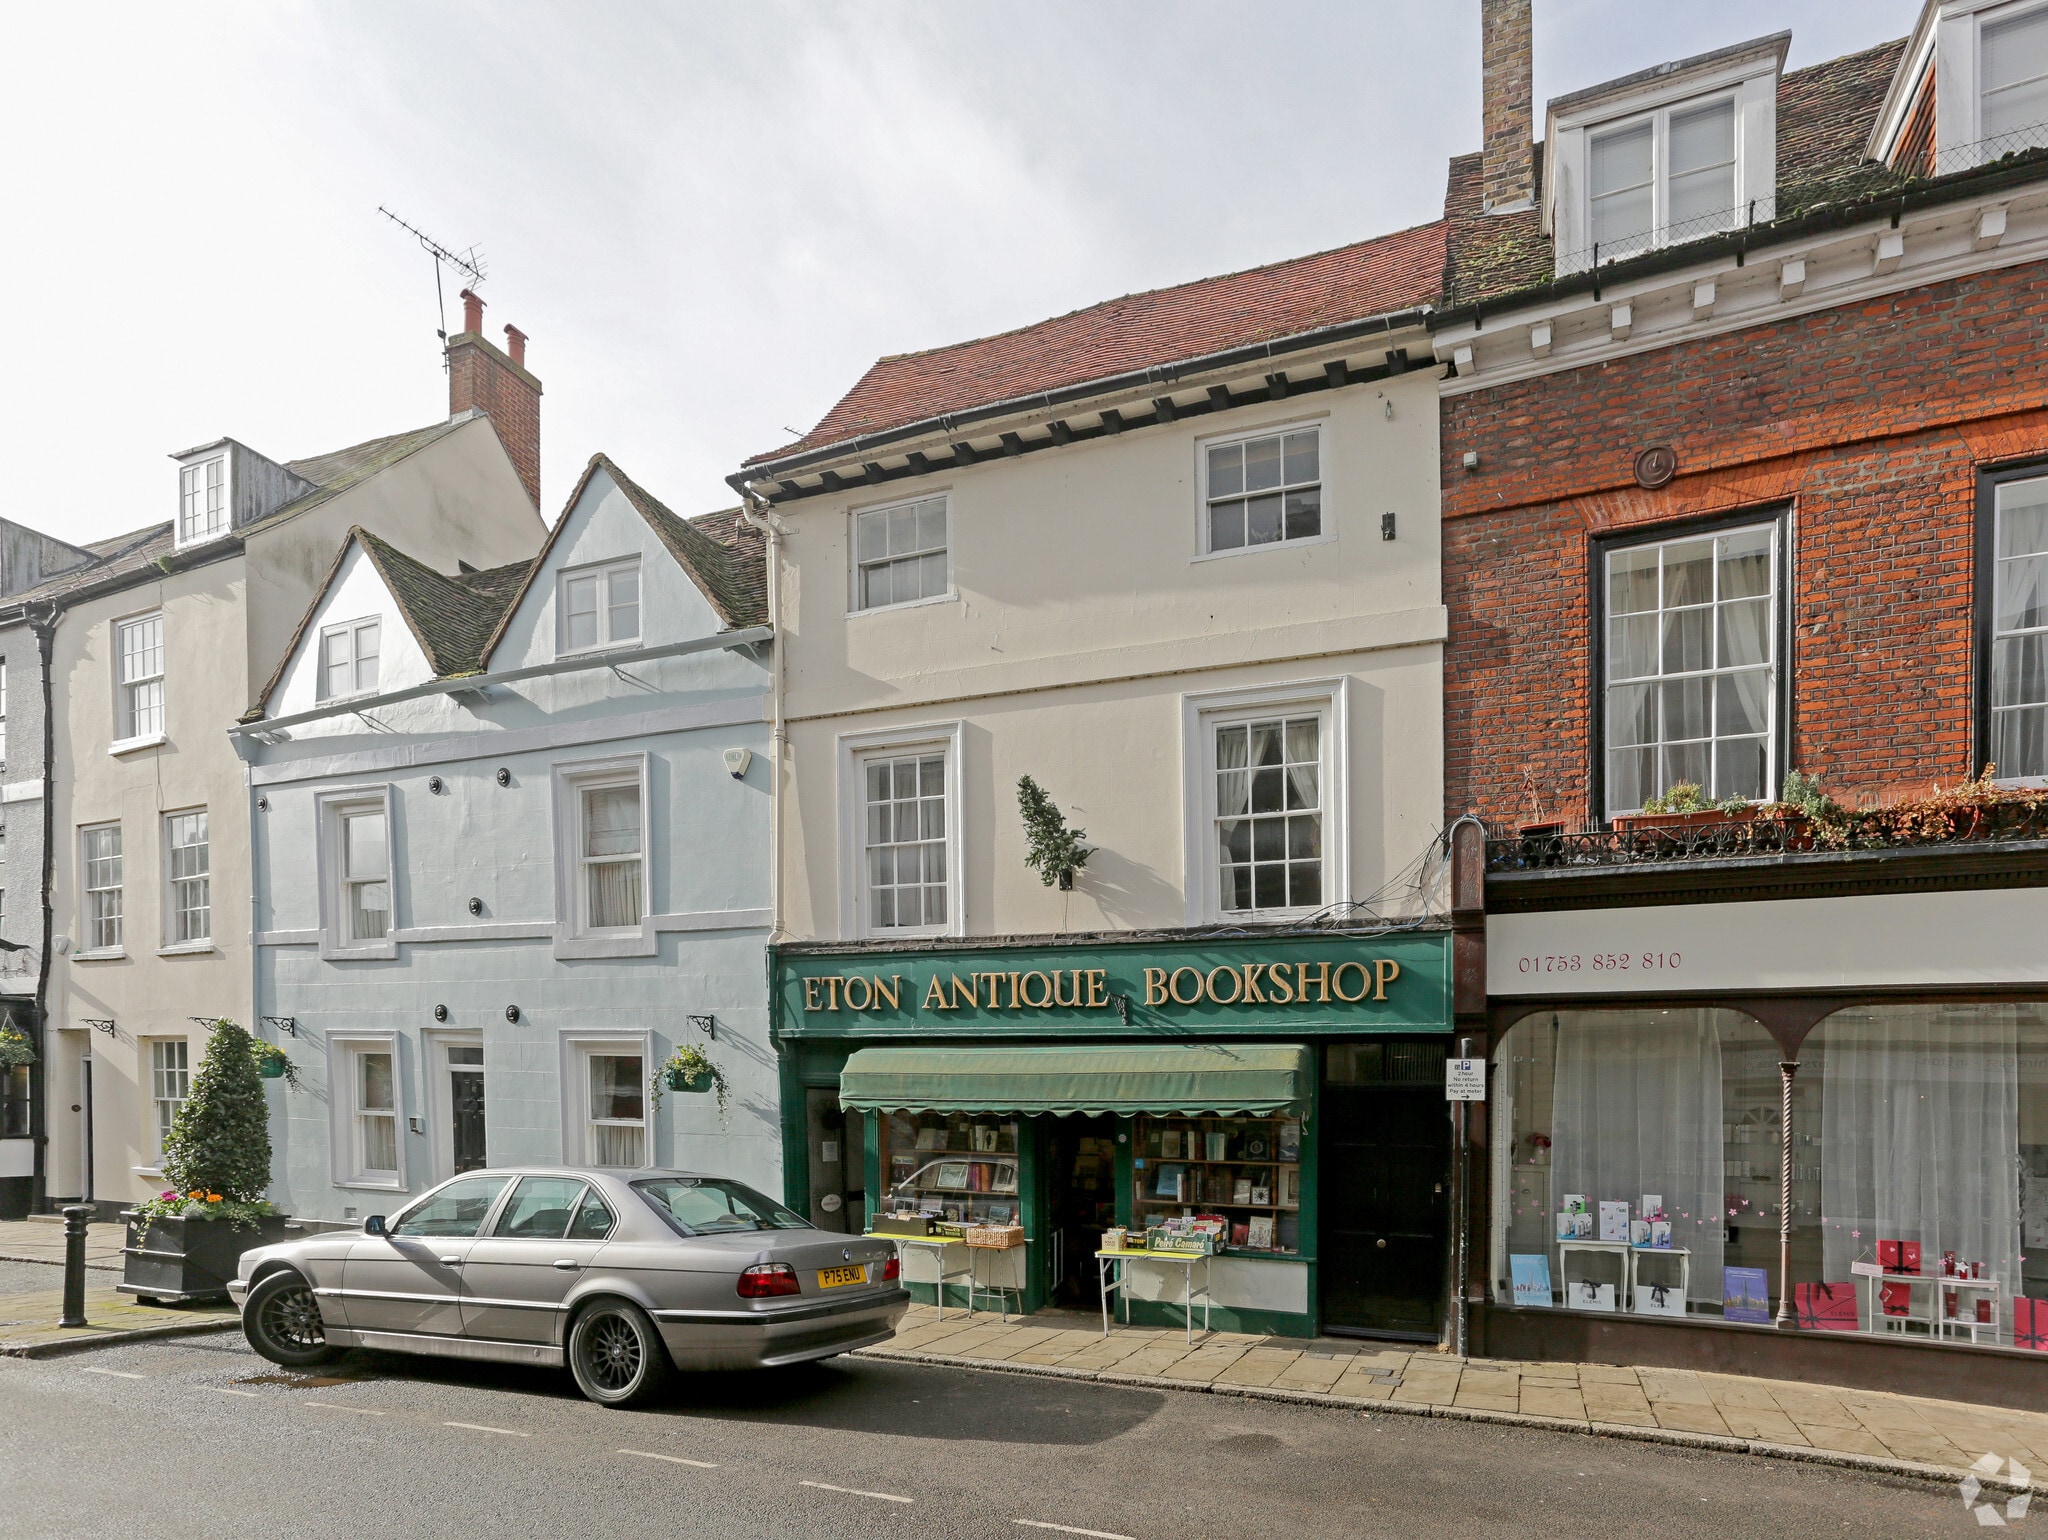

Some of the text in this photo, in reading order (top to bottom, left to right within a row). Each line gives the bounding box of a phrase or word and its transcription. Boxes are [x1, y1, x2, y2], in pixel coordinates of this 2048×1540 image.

[1518, 952, 1682, 973] 01753 852 810
[802, 959, 1400, 1011] ETON ANTIQUE BOOKSHOP
[1462, 1061, 1470, 1070] P
[1175, 1237, 1205, 1250] Camaró
[823, 1267, 861, 1285] P75 ENU
